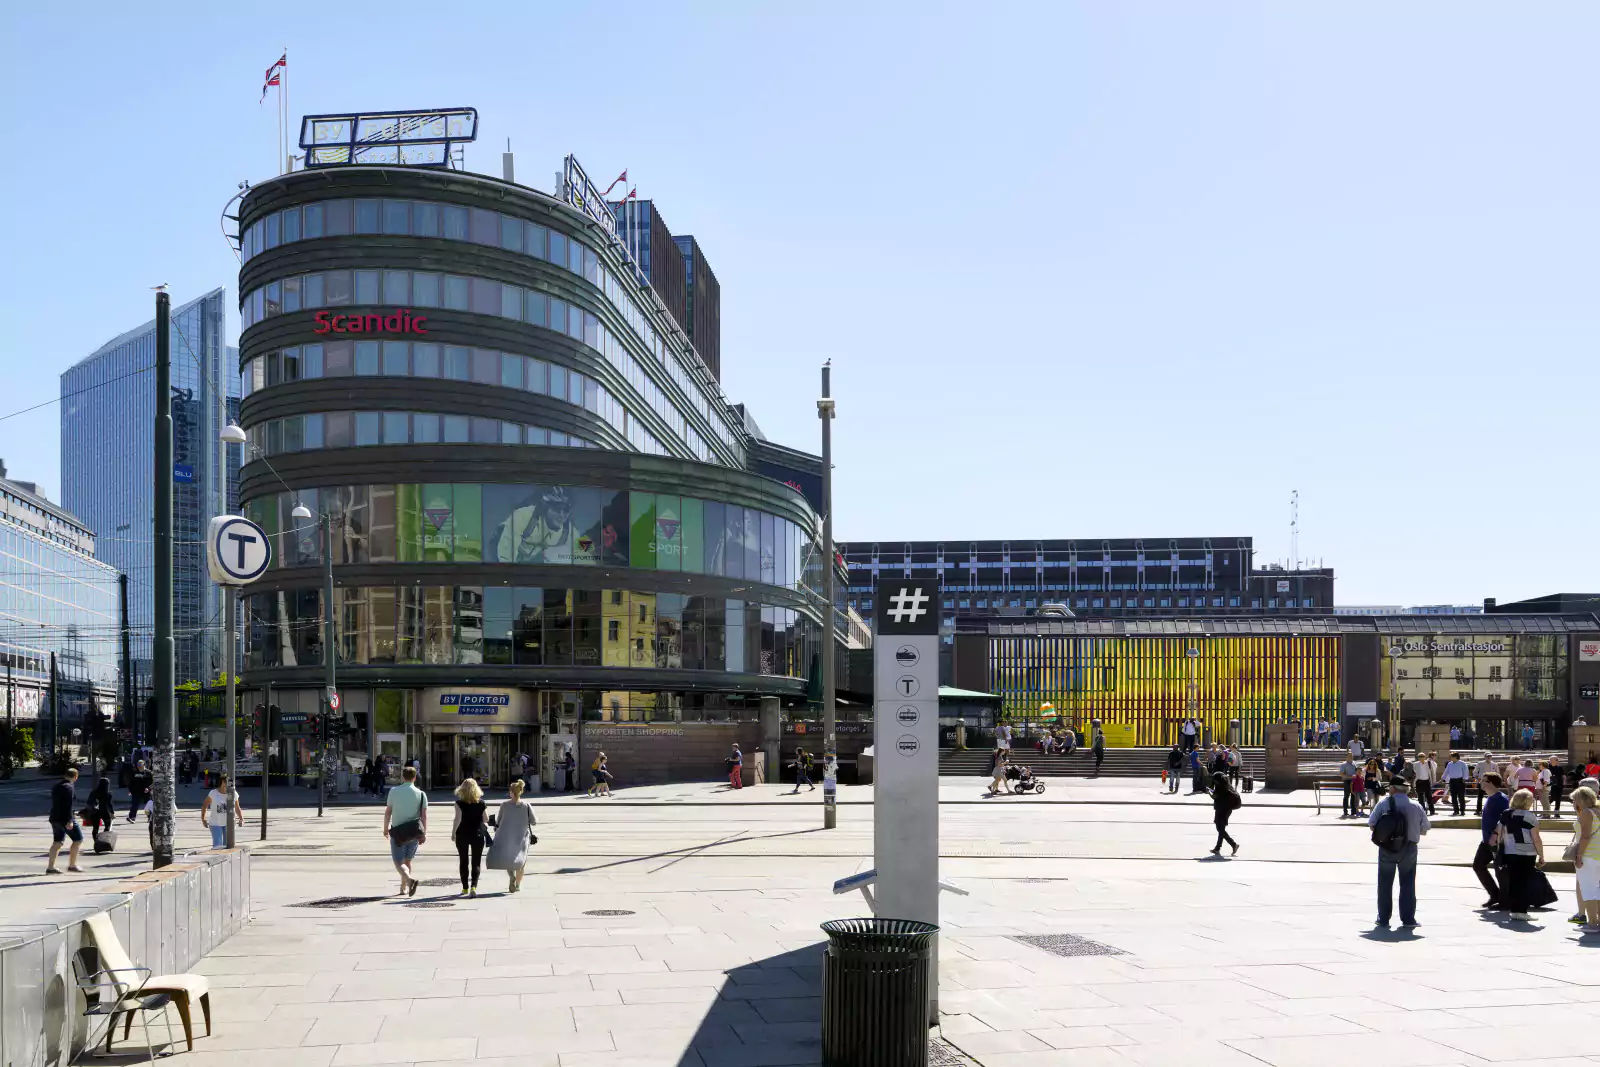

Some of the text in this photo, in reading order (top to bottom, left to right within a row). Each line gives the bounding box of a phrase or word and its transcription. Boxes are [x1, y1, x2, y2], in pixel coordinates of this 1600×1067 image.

[312, 308, 429, 334] Scandic
[416, 534, 461, 545] SPORT
[228, 532, 257, 570] T
[648, 542, 689, 555] SPORT
[1404, 641, 1505, 653] Oslo Sentralstasjon
[902, 679, 914, 694] T
[635, 728, 684, 736] SHOPPING
